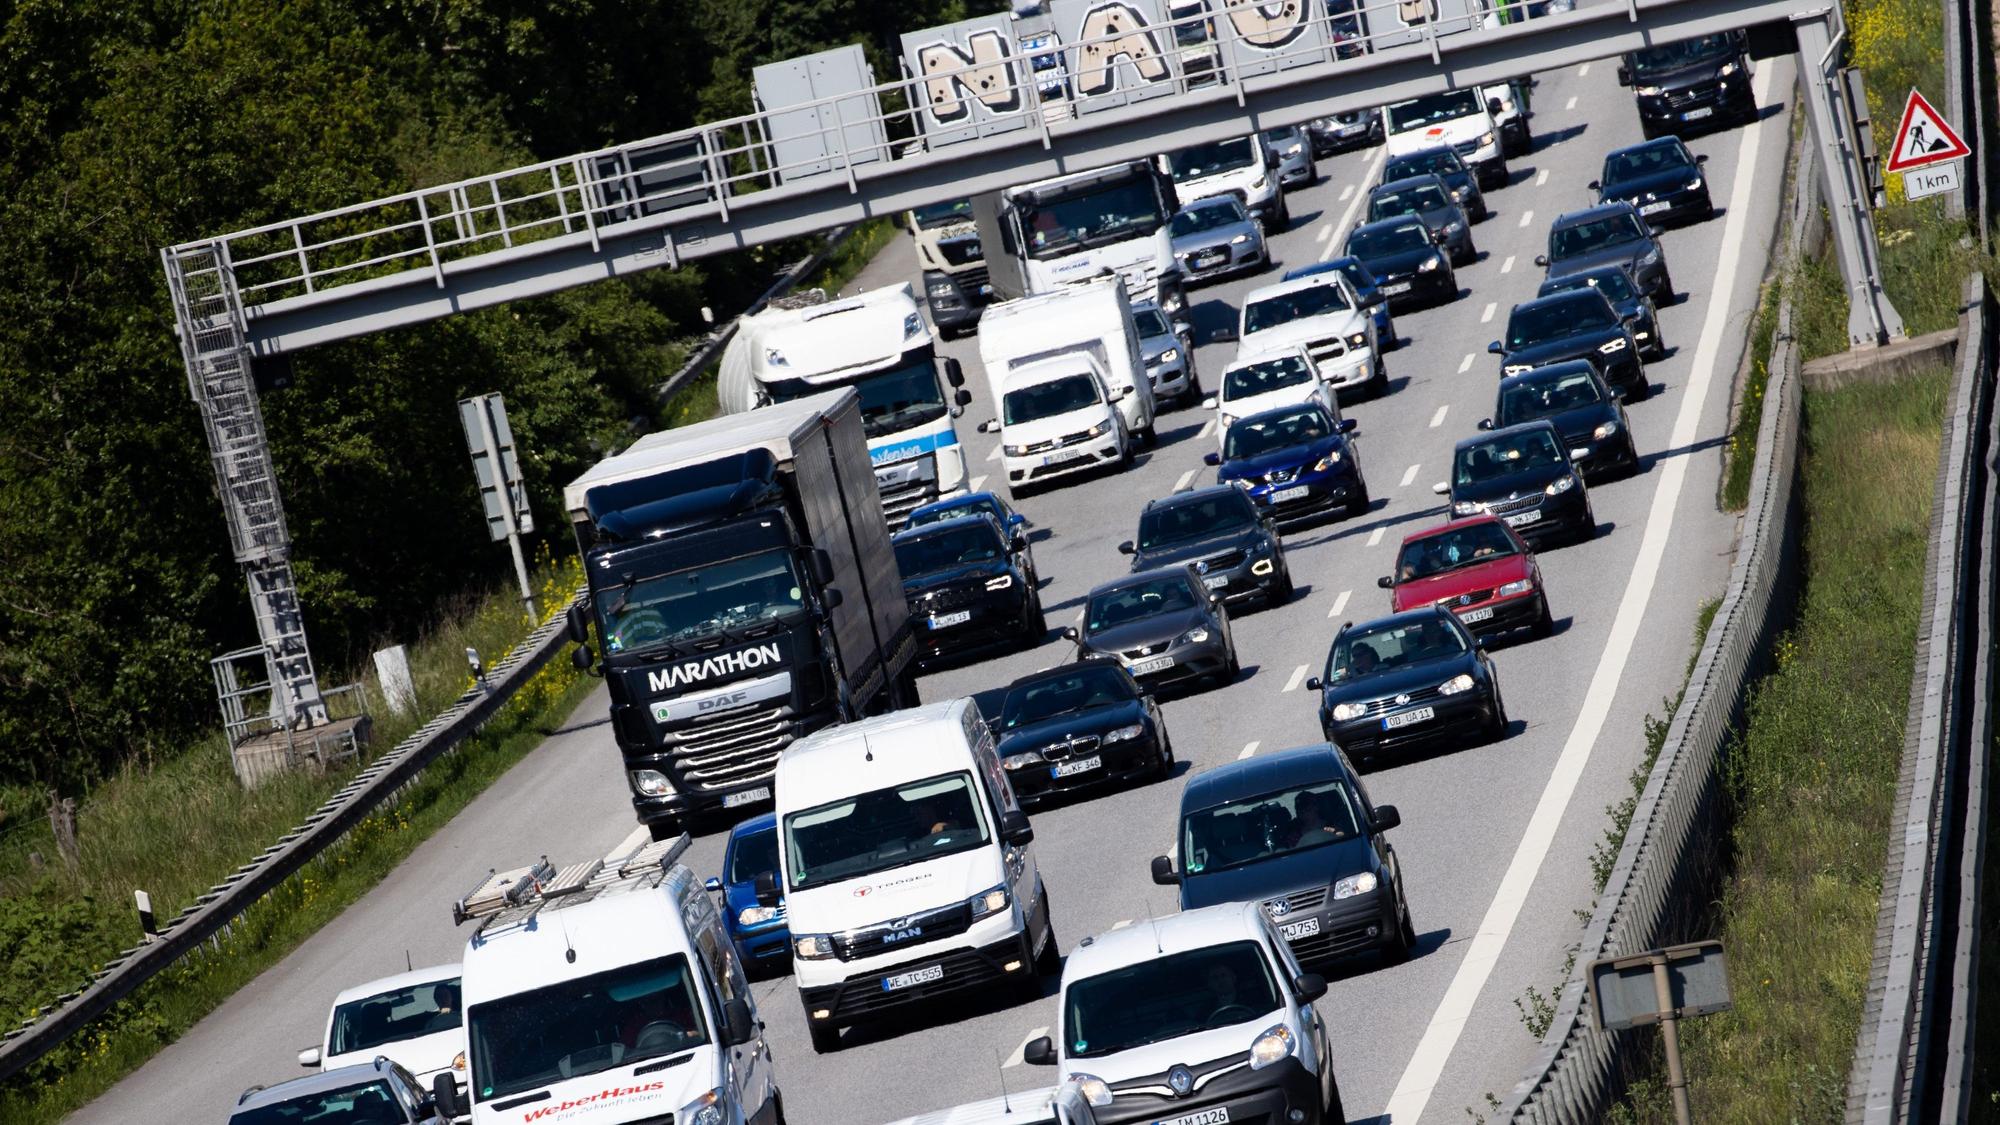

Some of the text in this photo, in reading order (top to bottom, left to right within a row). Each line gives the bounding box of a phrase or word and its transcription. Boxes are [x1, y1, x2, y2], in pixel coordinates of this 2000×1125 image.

[1916, 174, 1950, 190] 1 km
[876, 471, 898, 482] AF
[648, 642, 781, 692] MARATHON
[698, 692, 747, 711] DAF
[883, 927, 922, 943] MAN
[1281, 919, 1318, 937] MJ 753
[890, 967, 942, 989] WE TC 555
[524, 1081, 664, 1123] WeberHaus
[1196, 1110, 1227, 1125] 1126
